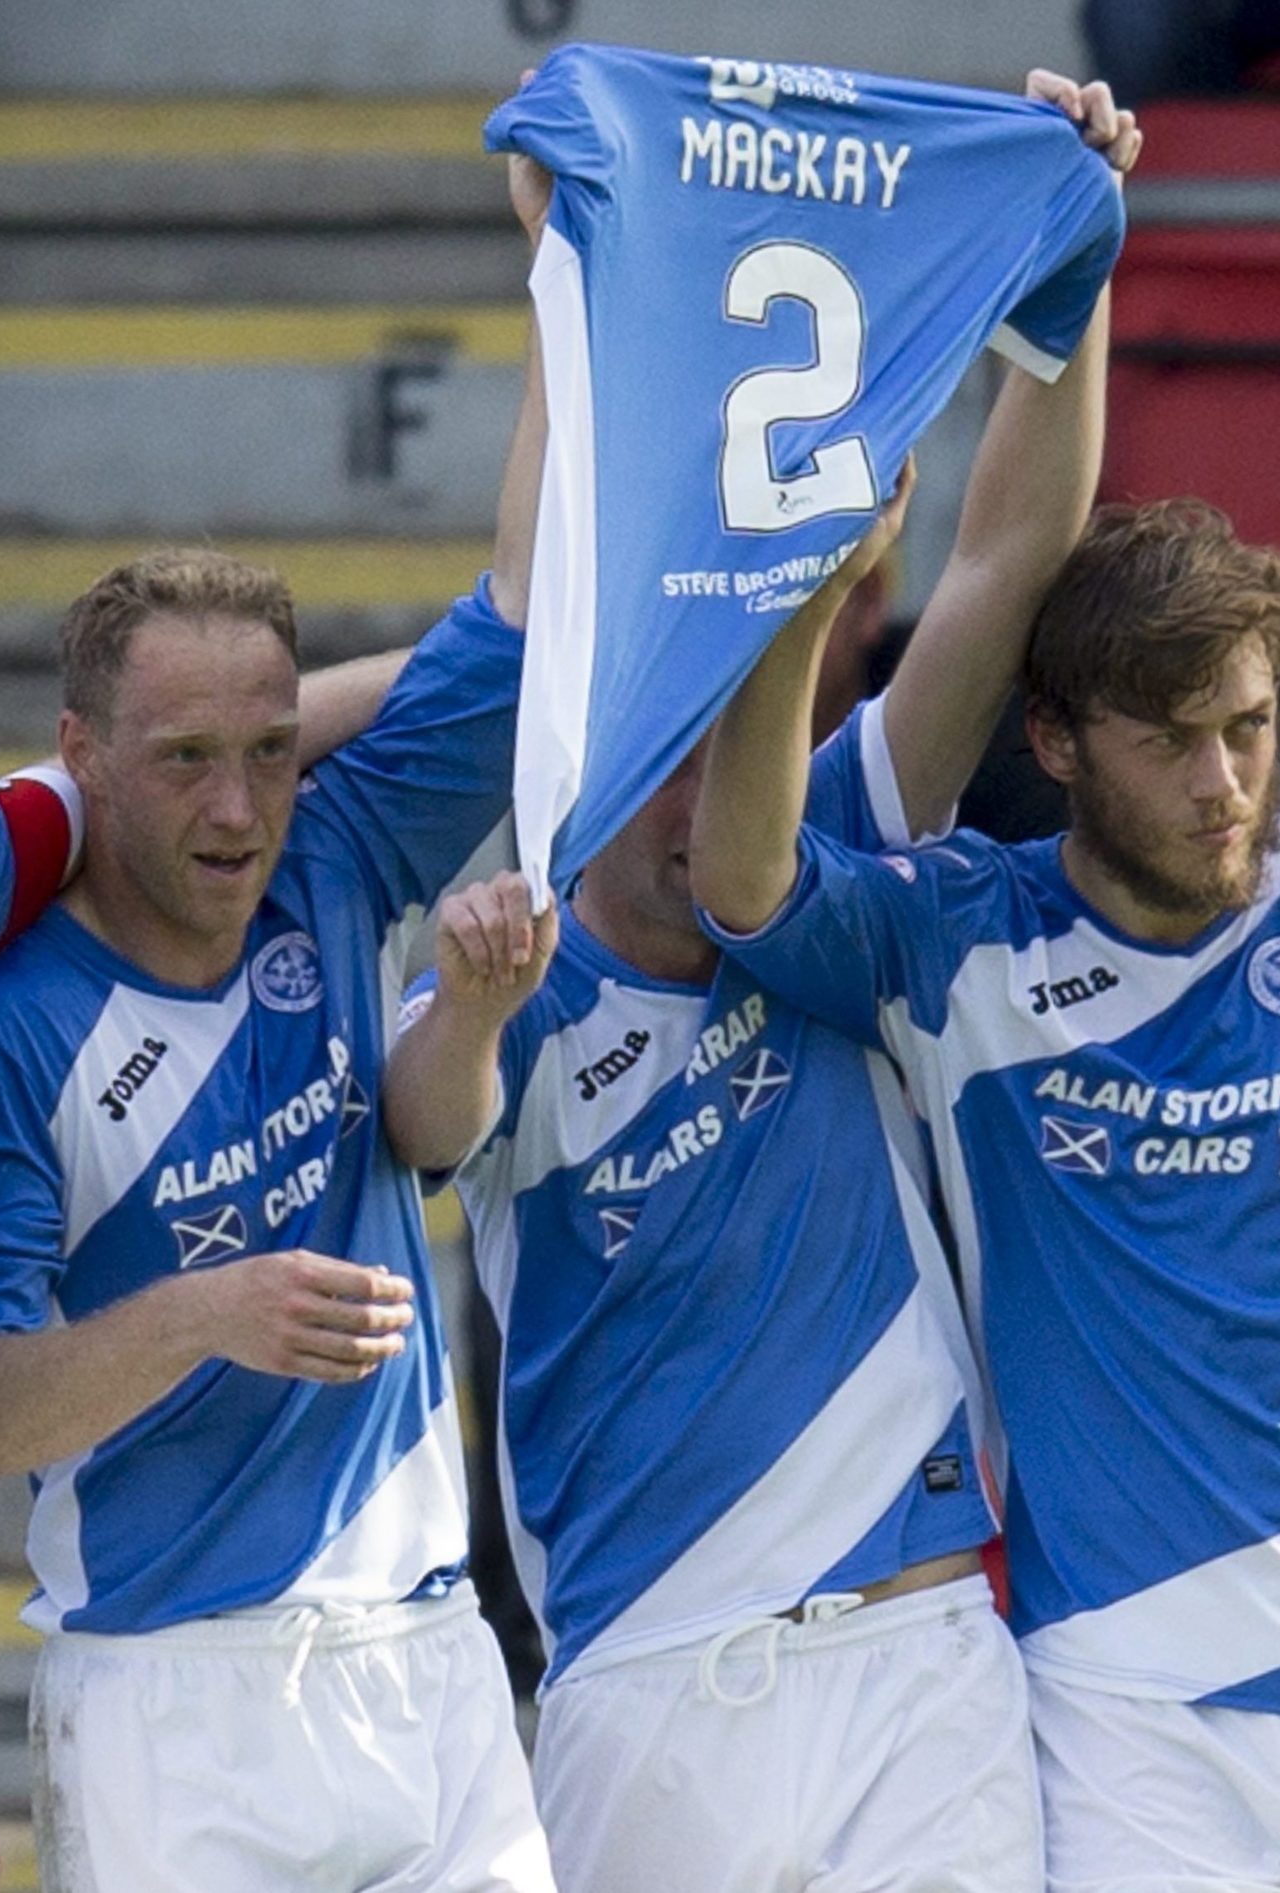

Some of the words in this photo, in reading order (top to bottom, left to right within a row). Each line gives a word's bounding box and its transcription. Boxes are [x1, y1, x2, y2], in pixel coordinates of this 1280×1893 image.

[681, 117, 911, 209] MACKAY
[718, 239, 878, 536] 2
[662, 570, 730, 598] STEVE
[734, 555, 823, 597] BROWN
[98, 1036, 168, 1122] Joma
[1035, 1068, 1156, 1121] ALAN
[153, 1139, 257, 1208] ALAN
[1133, 1136, 1254, 1176] CARS
